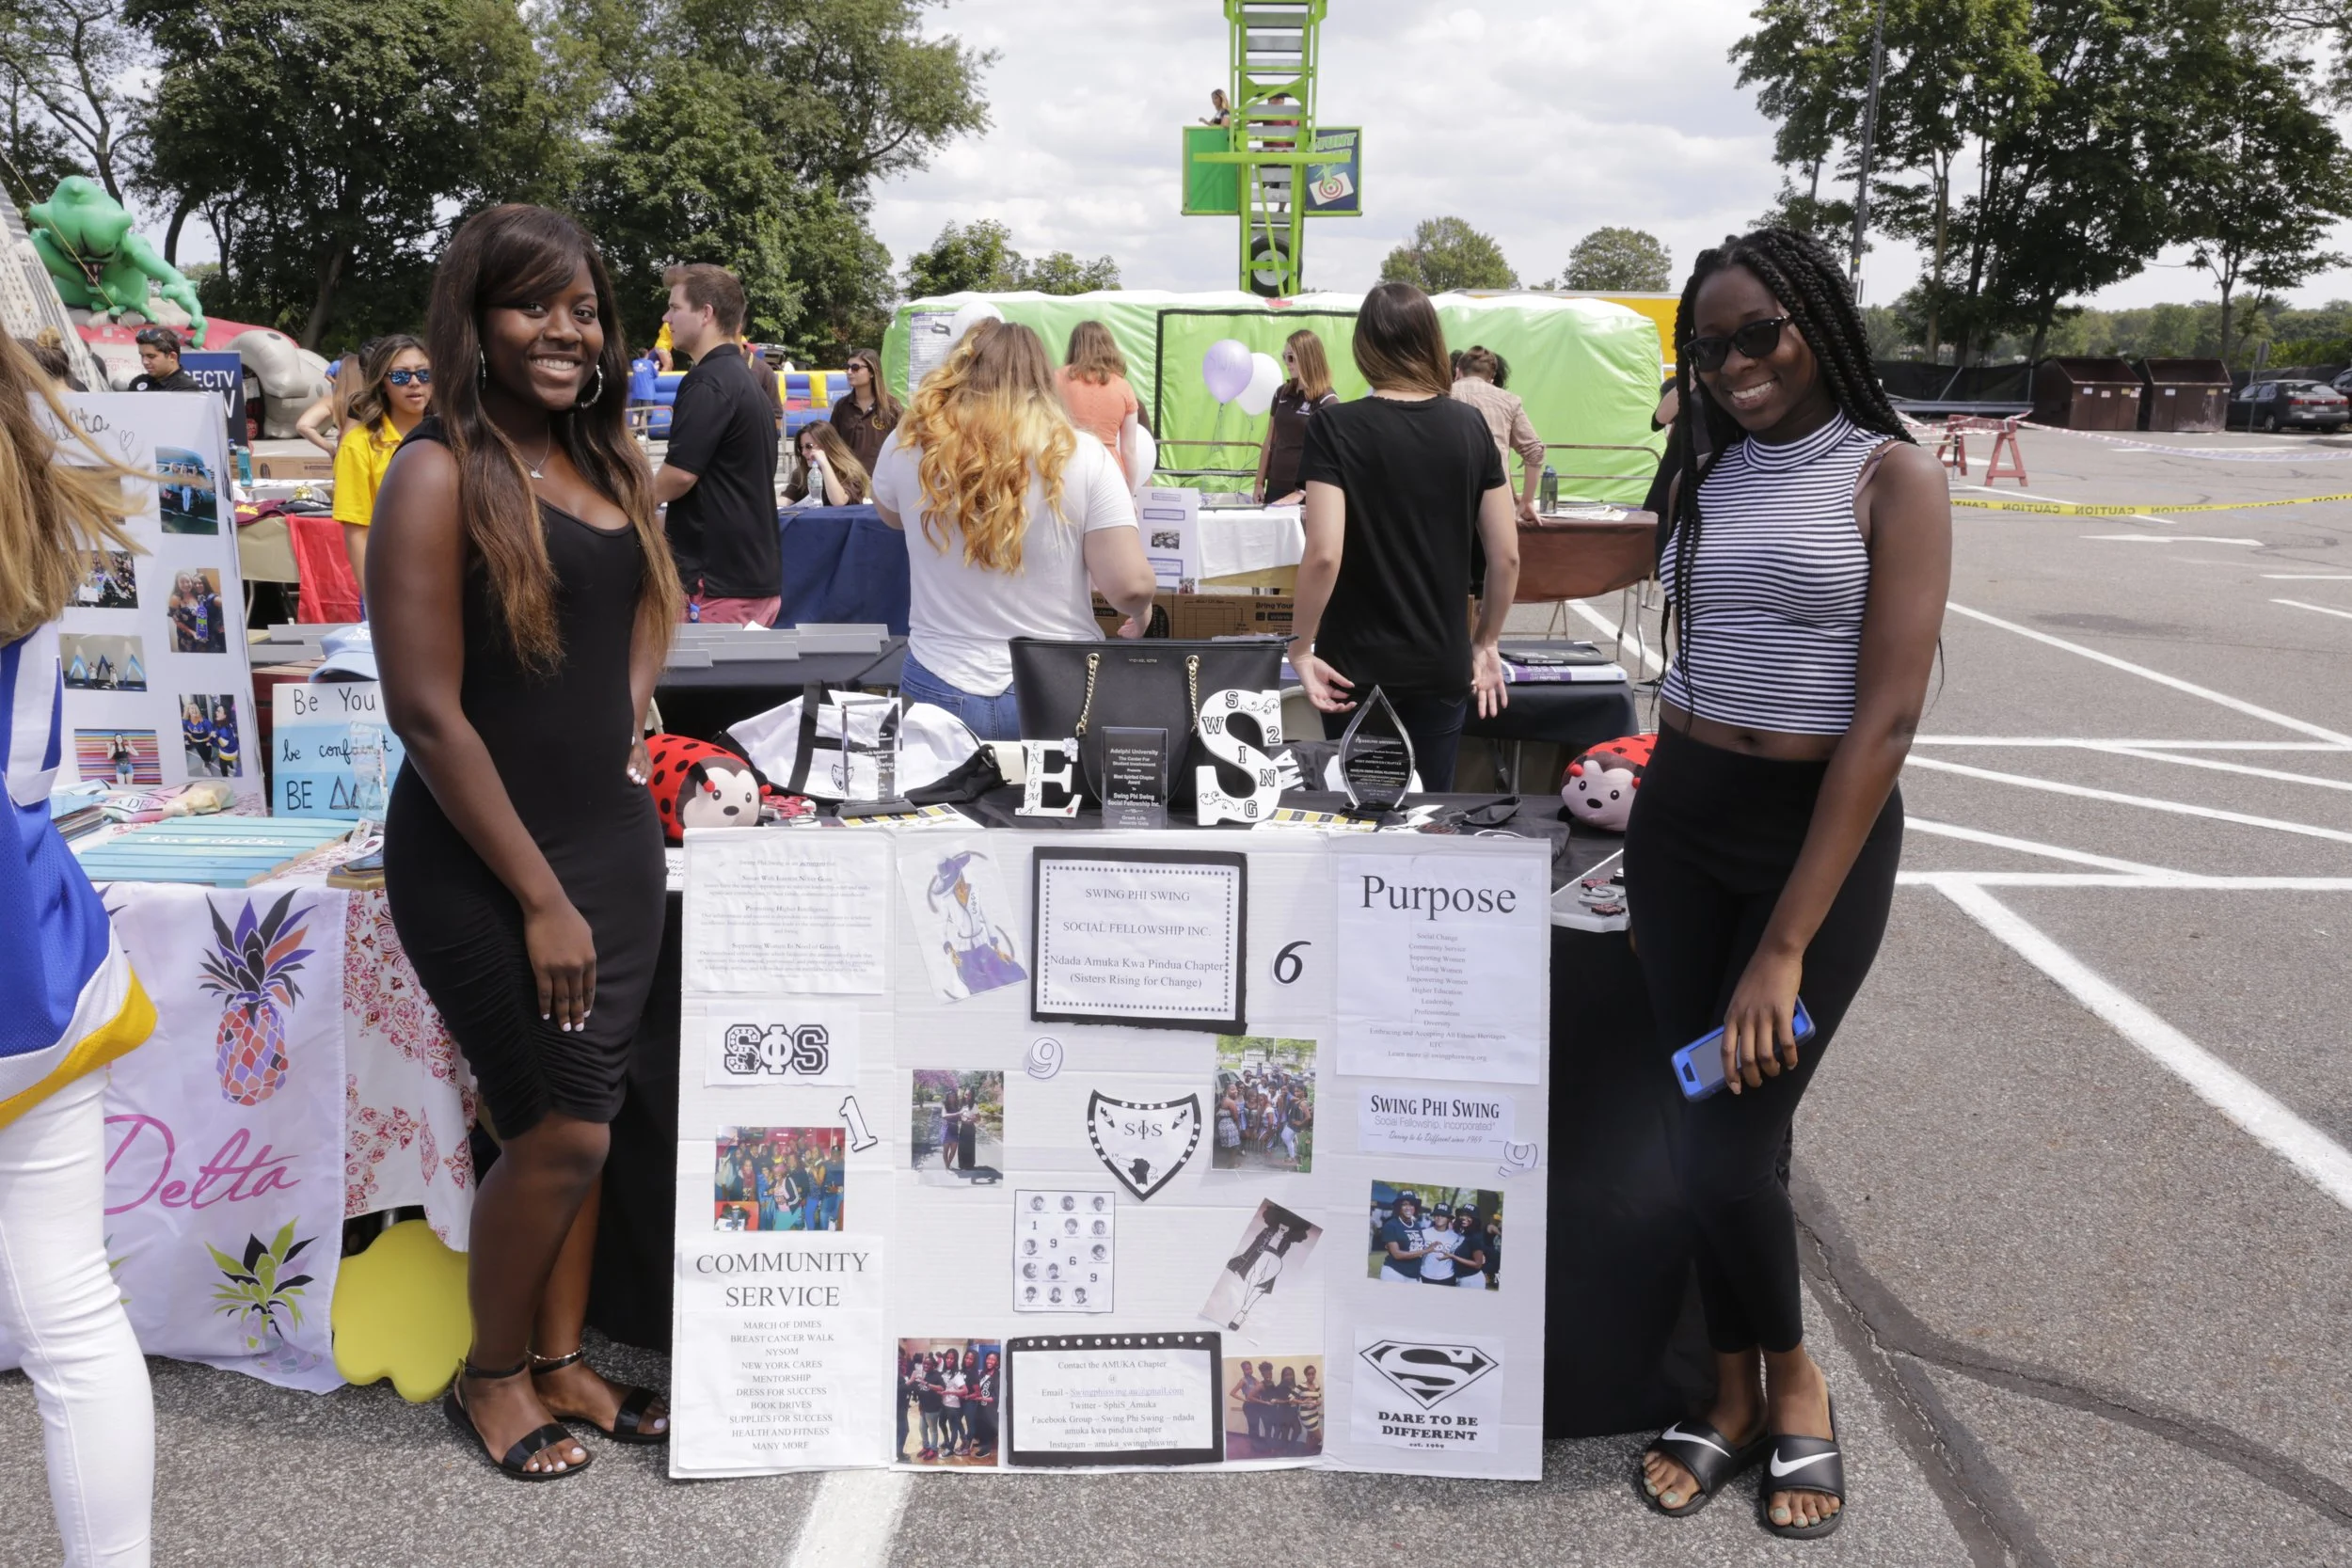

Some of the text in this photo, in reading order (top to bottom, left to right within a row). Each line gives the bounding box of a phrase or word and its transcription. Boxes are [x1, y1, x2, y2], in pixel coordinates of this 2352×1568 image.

[294, 687, 375, 715] Be You
[282, 739, 301, 762] be
[287, 781, 312, 810] BE
[1086, 888, 1190, 902] SWING PHI SWING
[1359, 875, 1517, 921] Purpose
[1063, 921, 1211, 937] SOCIAL FELLOWSHIP INC.
[1050, 956, 1224, 973] Ndada Amuka Kwa Pindua Chapter
[1273, 940, 1312, 985] 6
[1070, 973, 1202, 989] (Sisters Rising for Change)
[1027, 1037, 1064, 1080] 9
[839, 1095, 879, 1153] 1
[1375, 1116, 1398, 1126] Social
[103, 1113, 303, 1216] Delta
[1032, 1221, 1038, 1230] 1
[1050, 1239, 1057, 1248] 9
[696, 1252, 869, 1274] COMMUNITY
[1069, 1256, 1076, 1265] 6
[1089, 1273, 1097, 1282] 9
[726, 1286, 840, 1307] SERVICE
[779, 1321, 791, 1329] OF
[731, 1334, 834, 1343] BREAST CANCER WALK
[766, 1348, 799, 1356] NYSOM
[741, 1360, 822, 1370] NEW YORK CARES
[1058, 1361, 1086, 1370] Contact
[1102, 1360, 1136, 1369] AMUKA
[1137, 1360, 1167, 1370] Chapter
[753, 1374, 811, 1383] MENTORSHIP
[736, 1387, 827, 1397] DRESS FOR SUCCESS
[779, 1401, 812, 1409] DRIVES
[730, 1415, 771, 1423] SUPPLIES
[1032, 1416, 1067, 1424] Facebook
[1069, 1416, 1092, 1425] Group
[1101, 1415, 1124, 1424] Swing
[1141, 1415, 1164, 1424] Swing
[1378, 1412, 1478, 1426] DARE TO BE
[732, 1428, 830, 1437] HEALTH AND FITNESS
[1091, 1426, 1106, 1434] kwa
[1108, 1426, 1133, 1435] pindua
[1135, 1426, 1162, 1435] chapter
[1382, 1425, 1478, 1441] DIFFERENT
[753, 1441, 808, 1450] MANY MORE
[1049, 1441, 1086, 1449] Instagram
